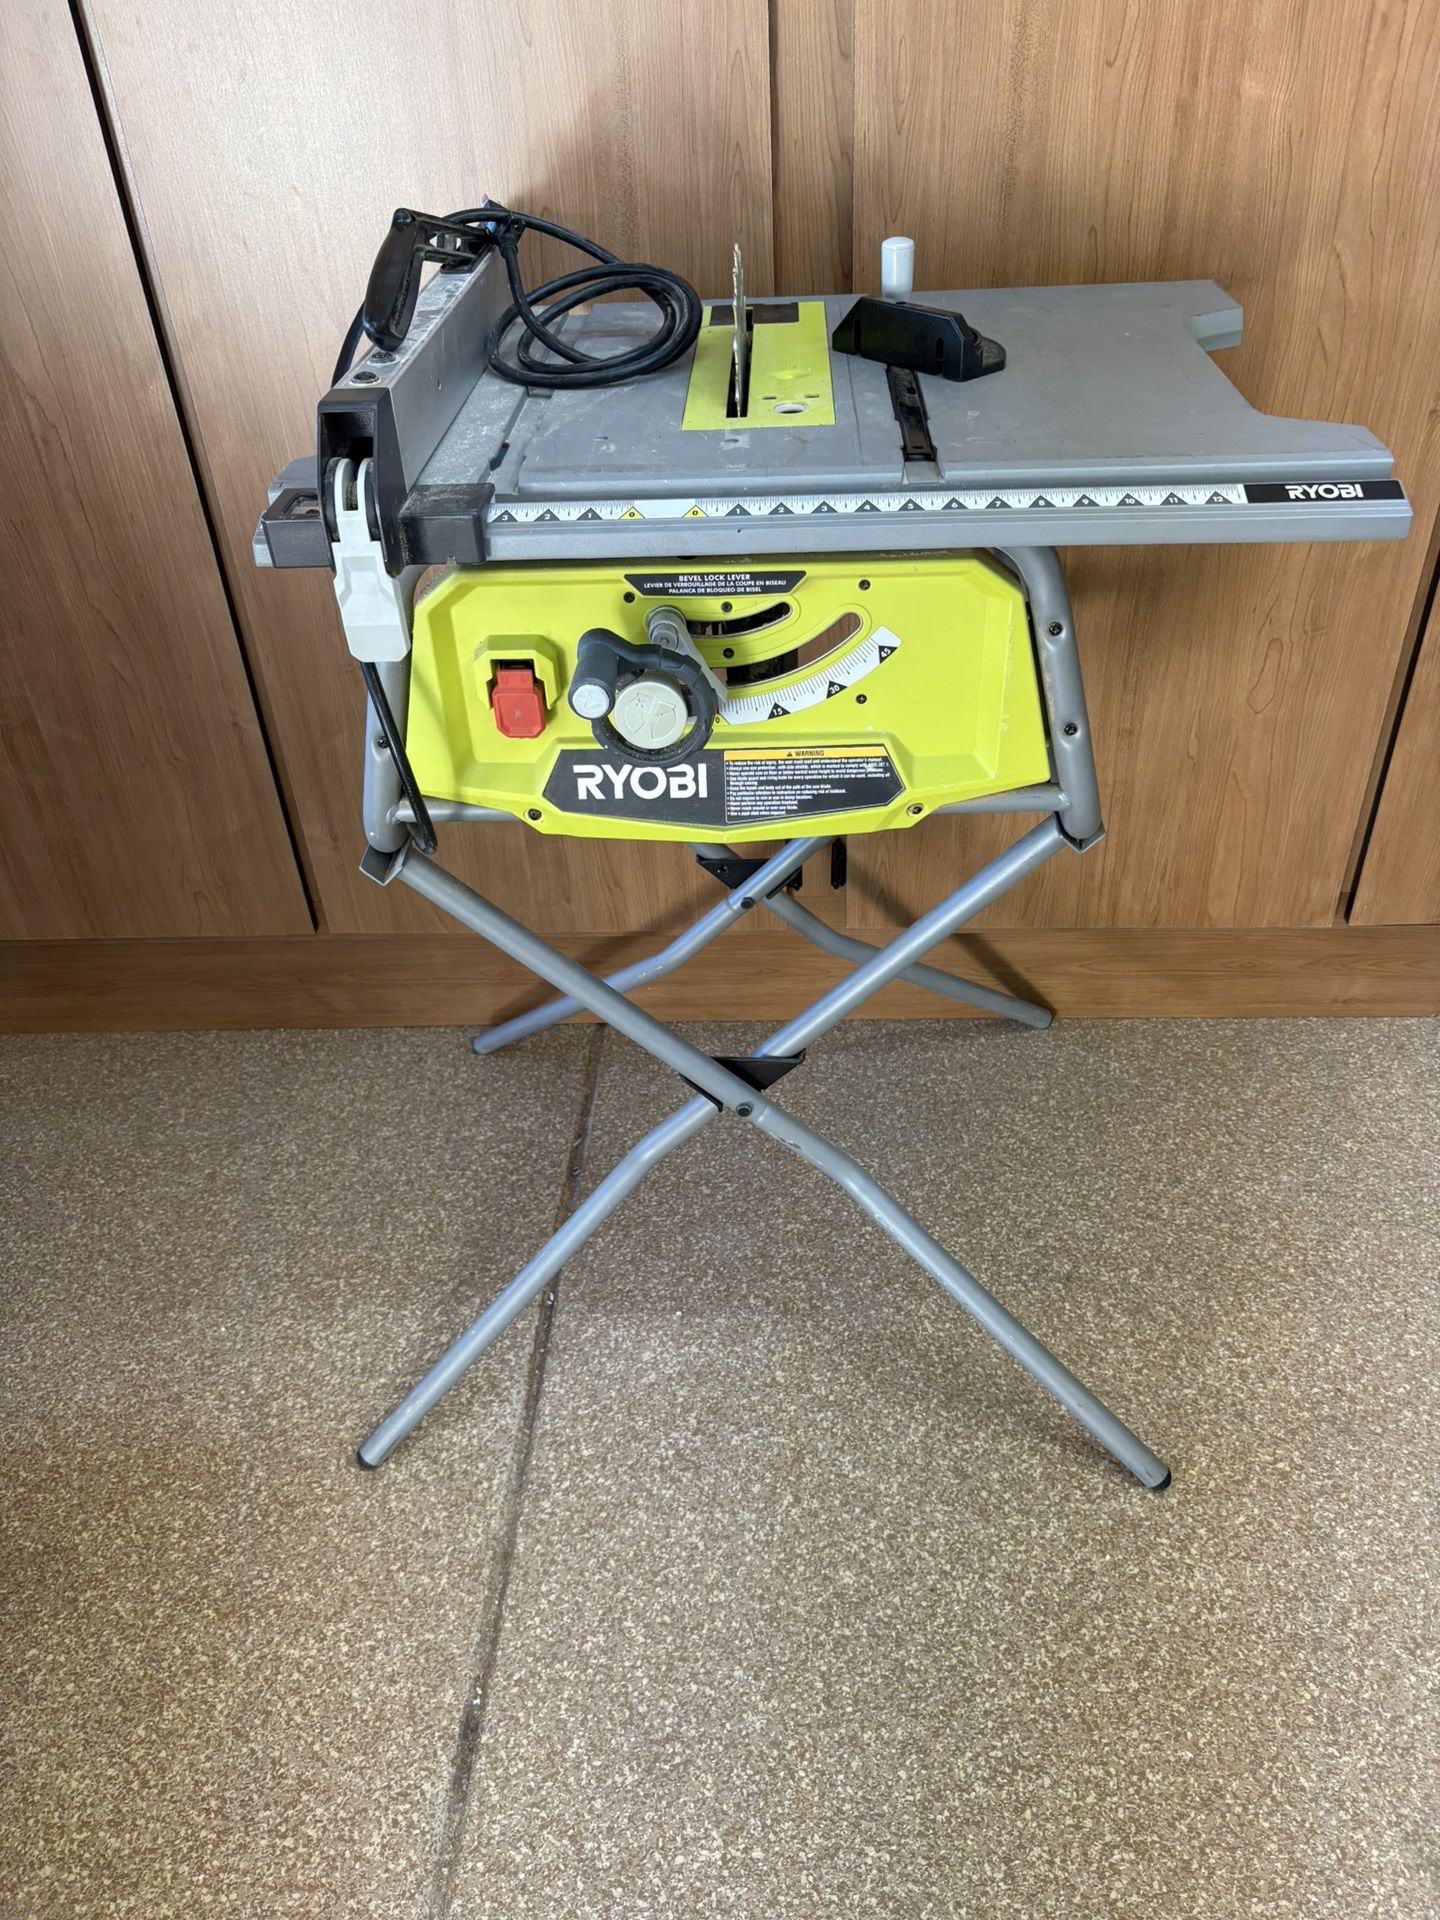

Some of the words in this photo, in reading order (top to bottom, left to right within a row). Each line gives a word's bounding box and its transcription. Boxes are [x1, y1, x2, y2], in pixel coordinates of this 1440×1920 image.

[1285, 484, 1364, 499] RYOBI
[881, 647, 891, 658] 45
[829, 684, 840, 694] 30
[773, 708, 783, 716] 15
[572, 763, 708, 800] RYOBI
